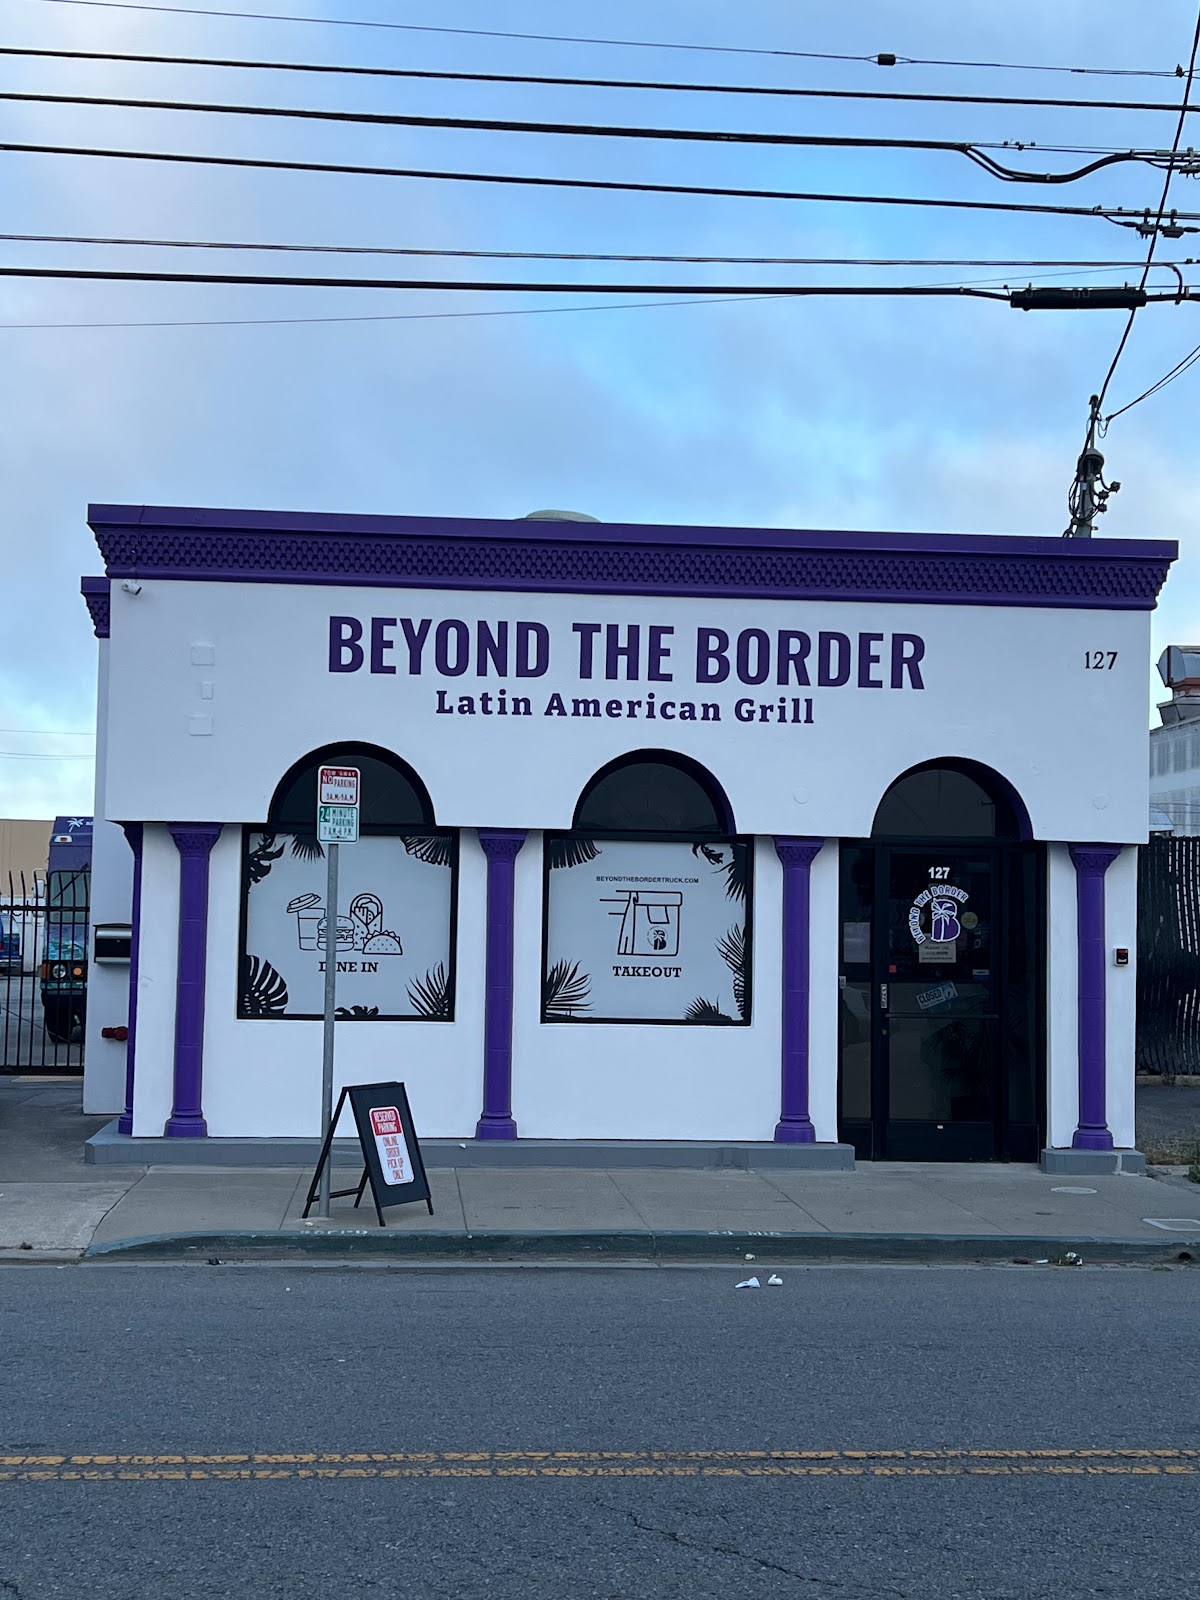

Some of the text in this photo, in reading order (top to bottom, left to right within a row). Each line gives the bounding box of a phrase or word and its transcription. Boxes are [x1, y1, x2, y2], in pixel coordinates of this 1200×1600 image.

[329, 616, 925, 689] BEYOND THE BORDER
[1086, 652, 1117, 669] 127
[436, 689, 814, 723] Latin American Grill
[322, 775, 356, 788] NO PARKING
[320, 808, 354, 822] 24 MINUTE
[332, 818, 355, 827] PARKING
[928, 867, 950, 879] 127
[931, 885, 969, 903] BORDER
[319, 962, 378, 972] DNE IN
[613, 966, 681, 977] TAKEOUT
[918, 989, 942, 1004] CLOSED
